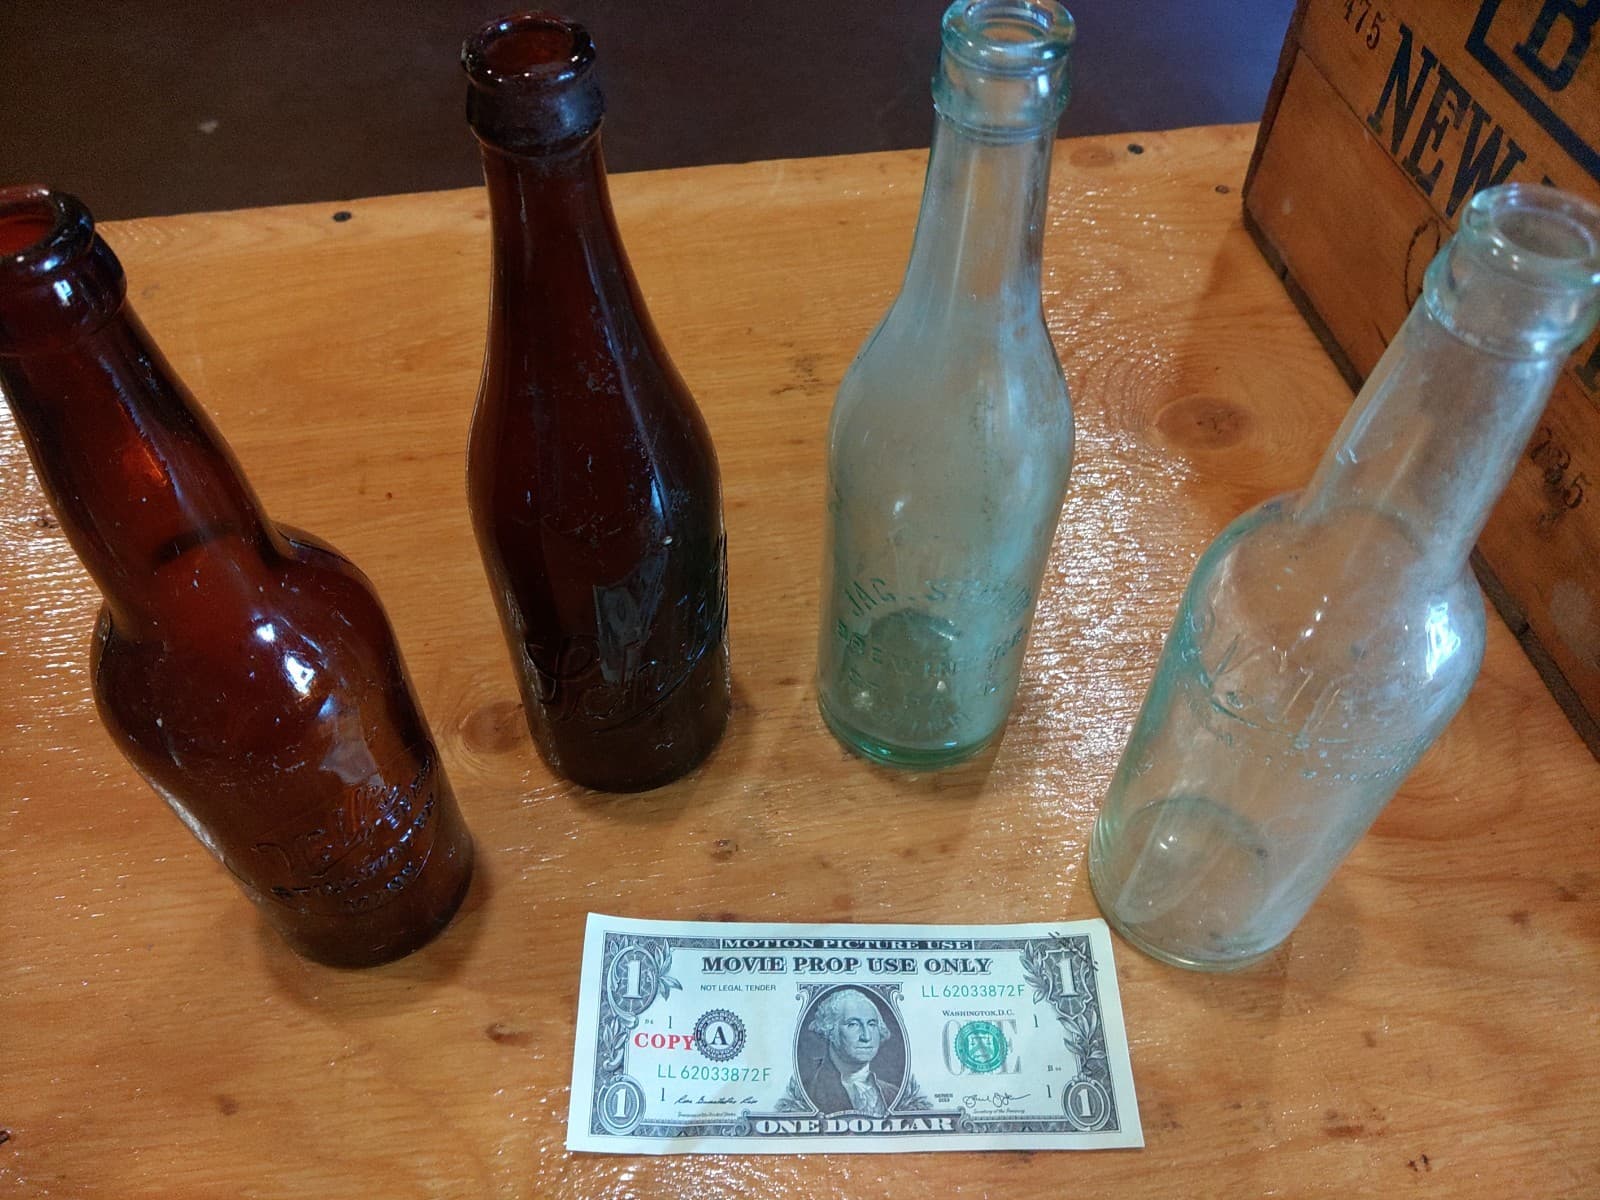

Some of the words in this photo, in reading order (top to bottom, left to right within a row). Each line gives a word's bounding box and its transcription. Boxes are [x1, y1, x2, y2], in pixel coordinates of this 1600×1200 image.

[1367, 22, 1527, 219] NEW
[724, 938, 816, 949] MOTION
[822, 939, 920, 950] PICTURE
[927, 940, 970, 950] USE
[702, 956, 787, 974] MOVIE
[793, 957, 861, 975] PROP
[867, 957, 918, 975] USE
[924, 957, 993, 975] ONLY
[622, 959, 643, 999] 1
[700, 984, 716, 992] NOT
[718, 984, 743, 992] LEGAL
[745, 984, 777, 992] TENDER
[1056, 957, 1080, 998] 1
[633, 1032, 696, 1051] COPY
[710, 1025, 729, 1046] A
[613, 1088, 628, 1118] 1
[1078, 1088, 1093, 1117] 1
[755, 1119, 820, 1134] ONE
[824, 1117, 954, 1134] DOLLAR
